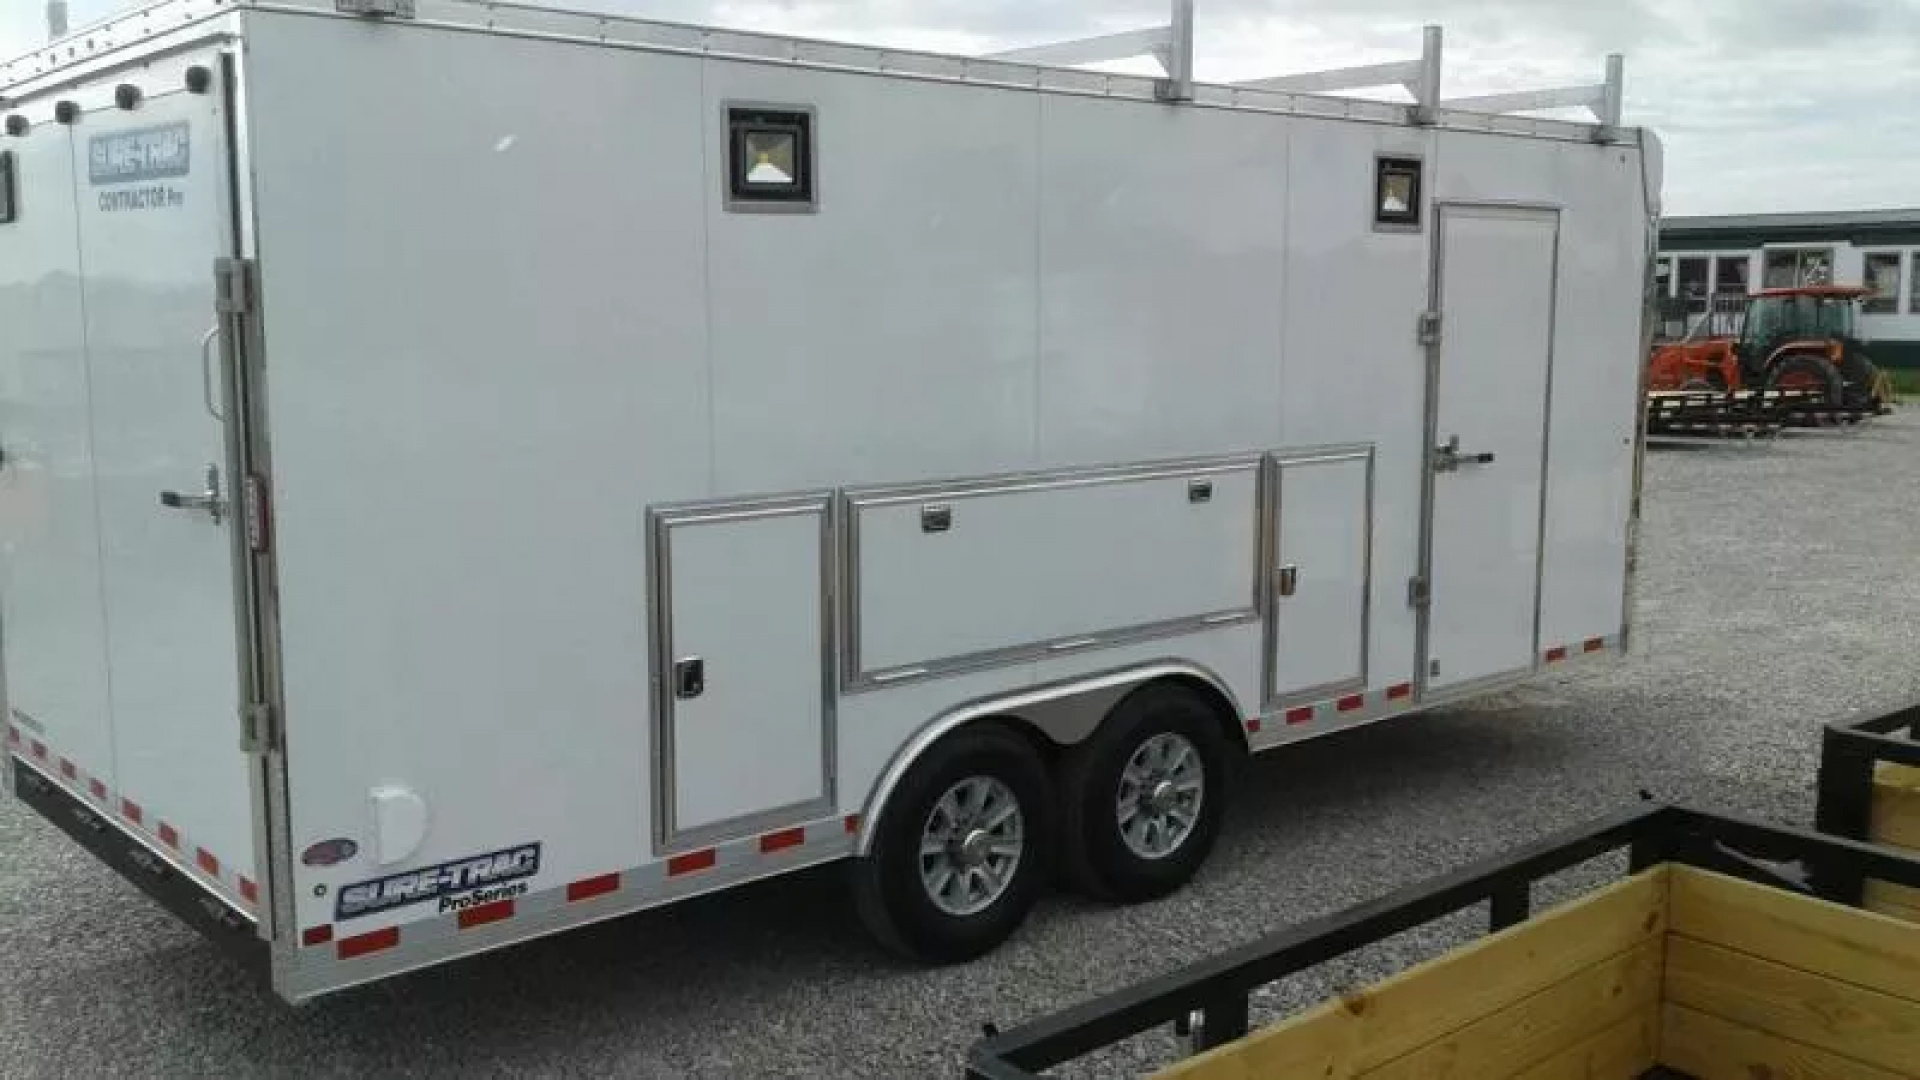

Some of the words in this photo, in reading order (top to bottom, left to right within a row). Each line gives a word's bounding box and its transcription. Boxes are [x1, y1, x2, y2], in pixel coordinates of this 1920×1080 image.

[91, 131, 187, 175] SURE-TRAC
[99, 187, 164, 211] CONTRACTOR
[341, 849, 536, 915] SURE-TRAC
[438, 881, 527, 913] ProSeries
